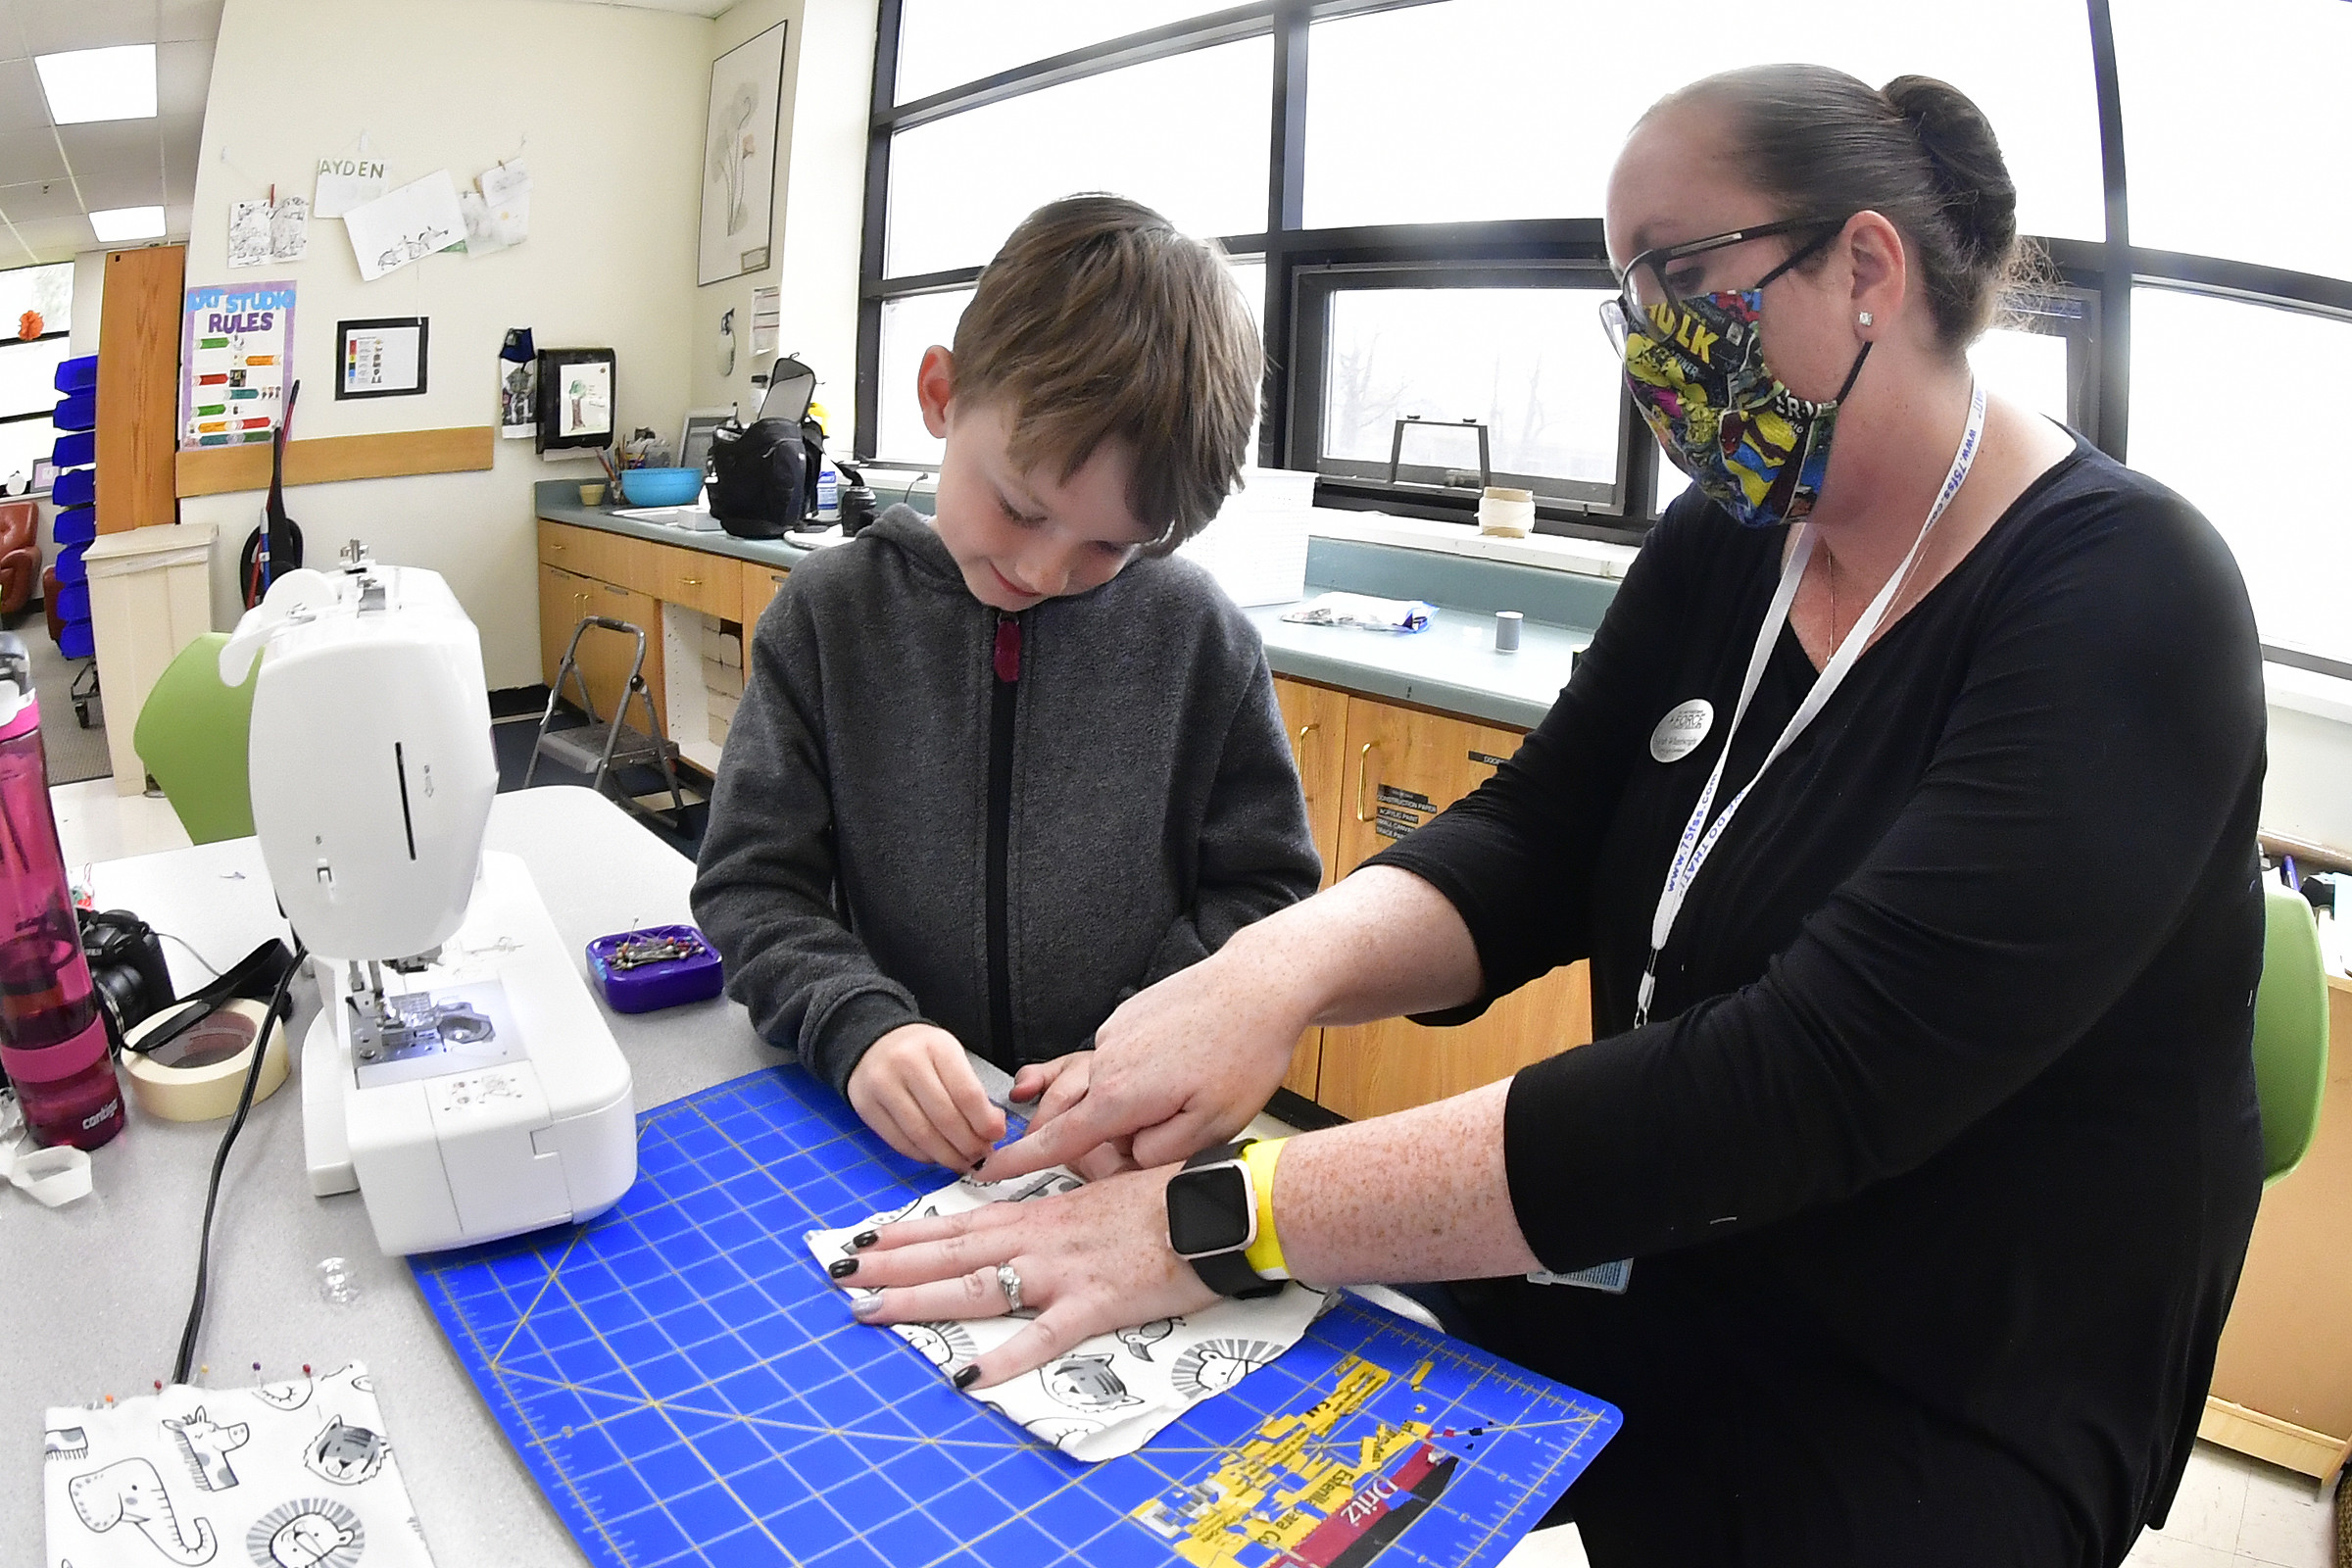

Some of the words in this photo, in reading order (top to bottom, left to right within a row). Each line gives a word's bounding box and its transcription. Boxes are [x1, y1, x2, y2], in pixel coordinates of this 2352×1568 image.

[319, 160, 384, 178] AYDEN
[186, 288, 224, 313] ART
[225, 290, 296, 314] STUDIO
[208, 313, 273, 333] RULES
[1667, 772, 1717, 892] www.75fss.com
[82, 1097, 118, 1129] contigo
[1340, 1479, 1398, 1526] Dritz
